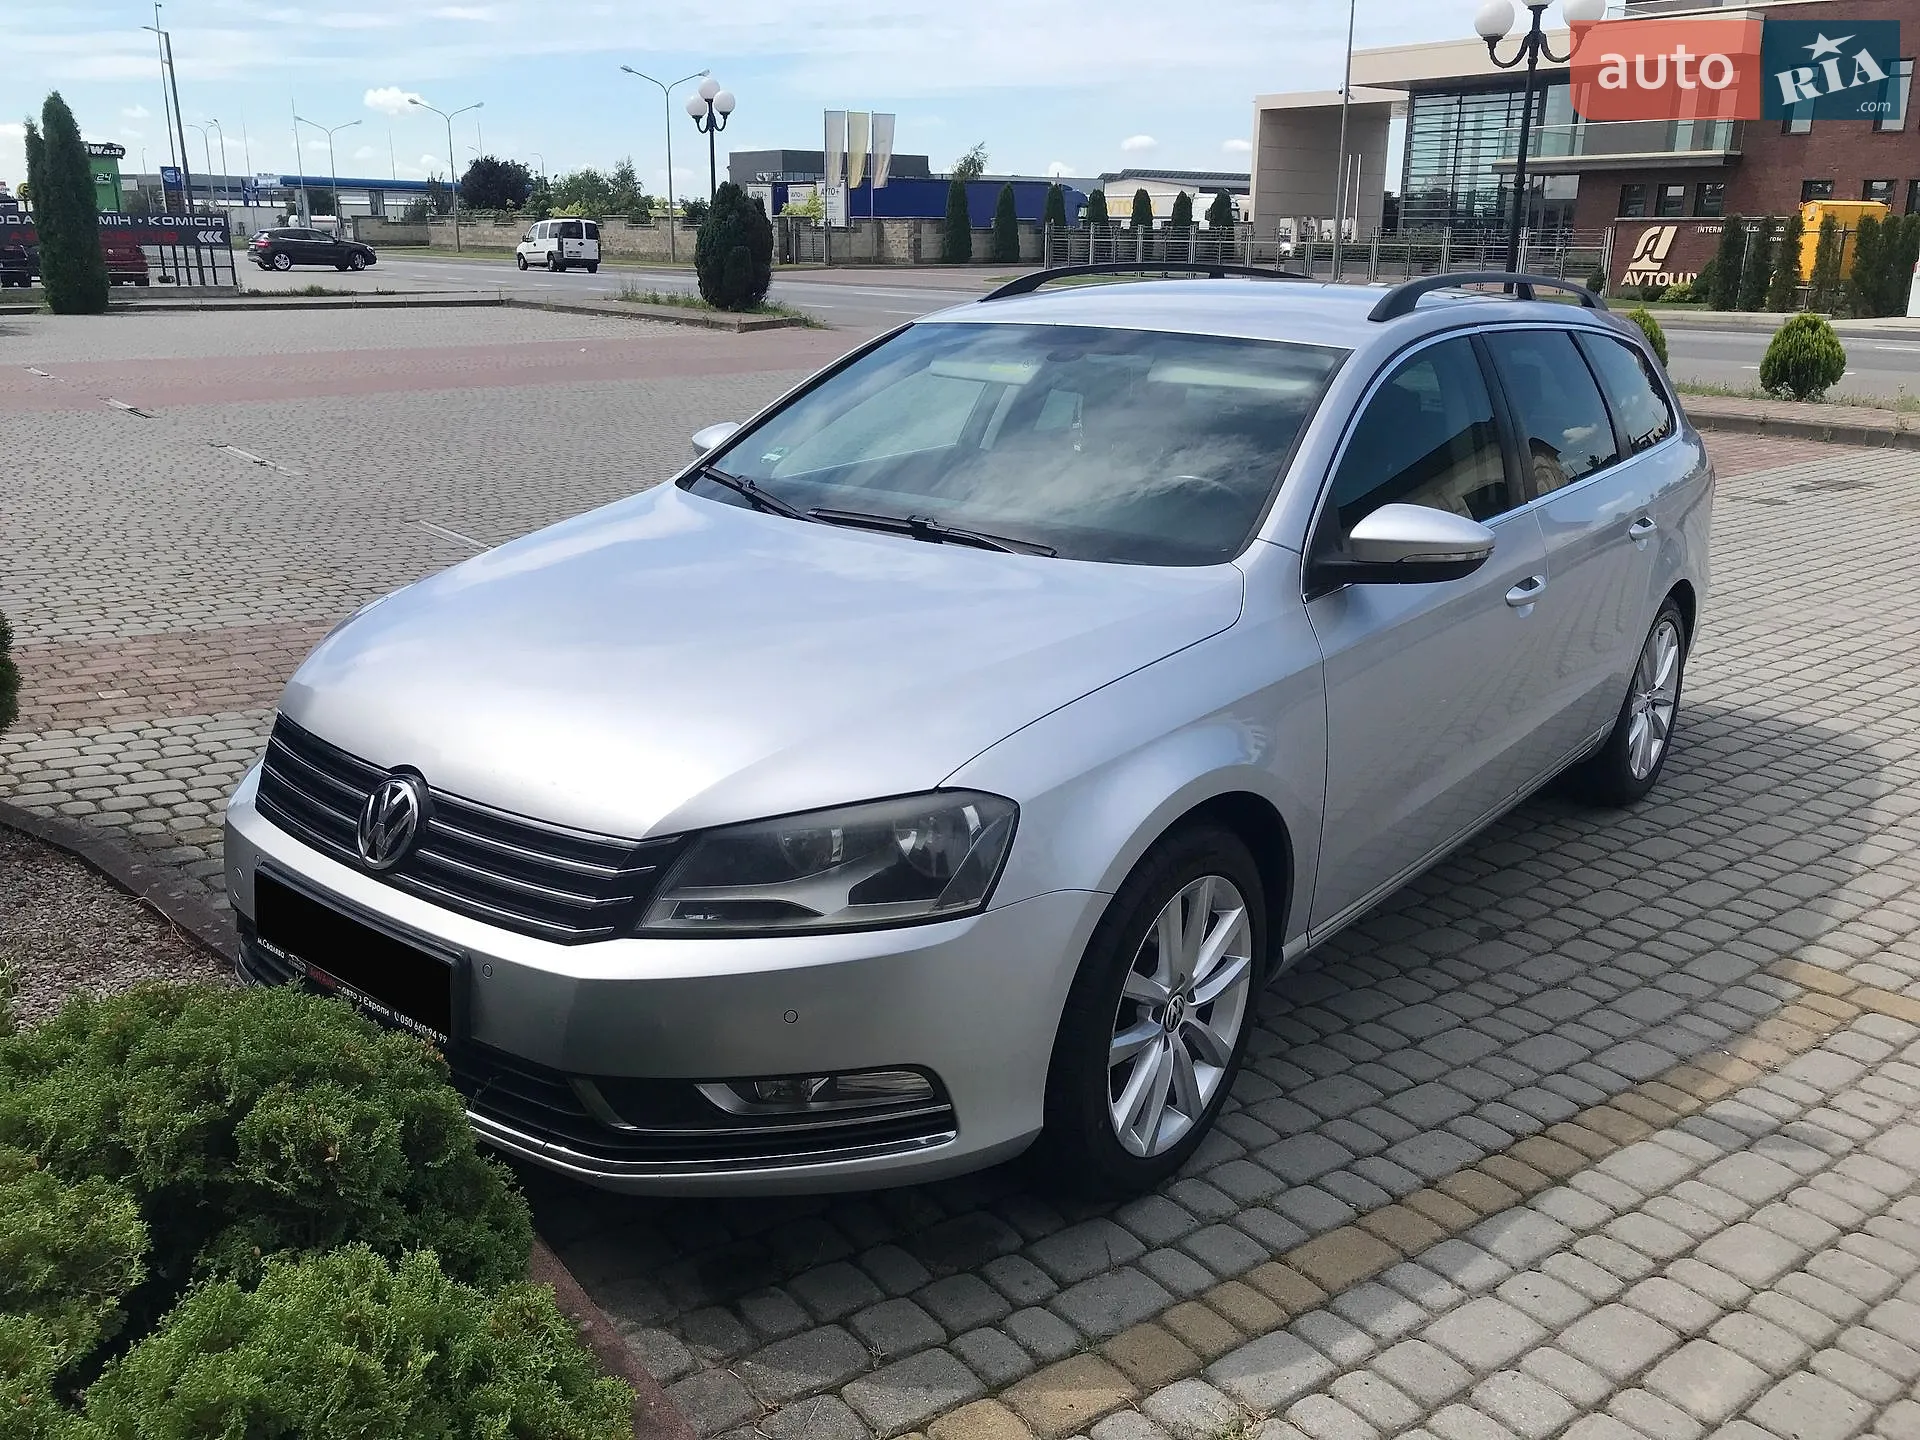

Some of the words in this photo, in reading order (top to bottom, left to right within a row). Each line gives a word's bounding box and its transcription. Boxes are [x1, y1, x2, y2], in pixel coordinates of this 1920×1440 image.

[90, 145, 123, 156] Wash
[96, 173, 112, 181] 24
[400, 1014, 413, 1028] 050
